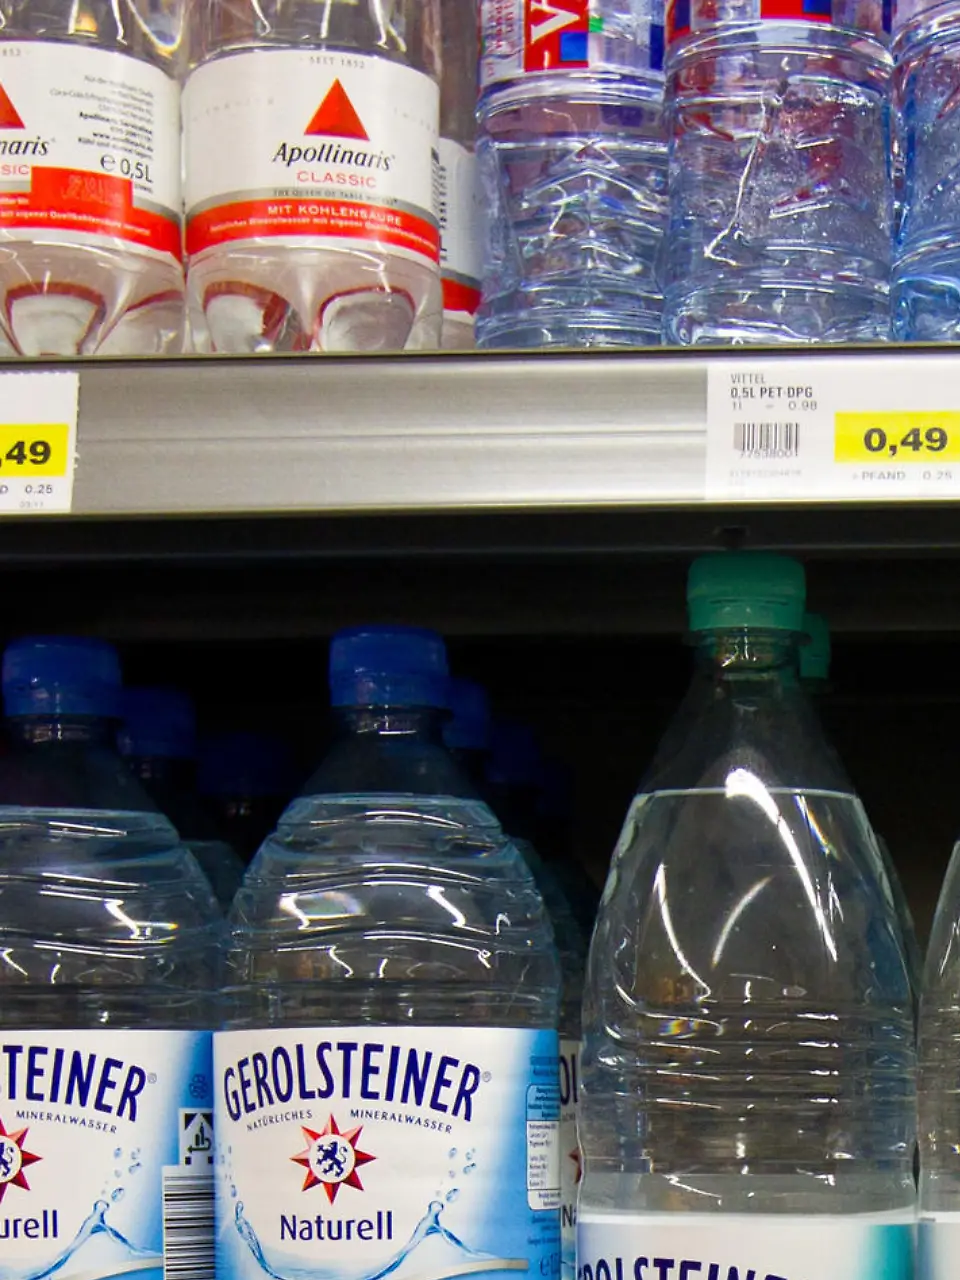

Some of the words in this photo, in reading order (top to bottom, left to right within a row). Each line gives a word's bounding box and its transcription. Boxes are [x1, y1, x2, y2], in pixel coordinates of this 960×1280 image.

[273, 142, 391, 172] Apollinaris
[120, 158, 153, 183] 0,5L
[296, 170, 377, 188] CLASSIC
[267, 205, 292, 215] MIT
[298, 204, 402, 225] KOHLENSÄURE
[730, 373, 766, 384] VITTEL
[863, 426, 948, 458] 0,49
[861, 470, 906, 481] PFAND
[922, 470, 952, 480] 0.25
[223, 1041, 481, 1122] GEROLSTEINER
[15, 1109, 118, 1134] MINERALWASSER
[246, 1109, 313, 1132] NATÜRLICHES
[350, 1108, 453, 1134] MINERALWASSER
[280, 1211, 393, 1241] Naturell
